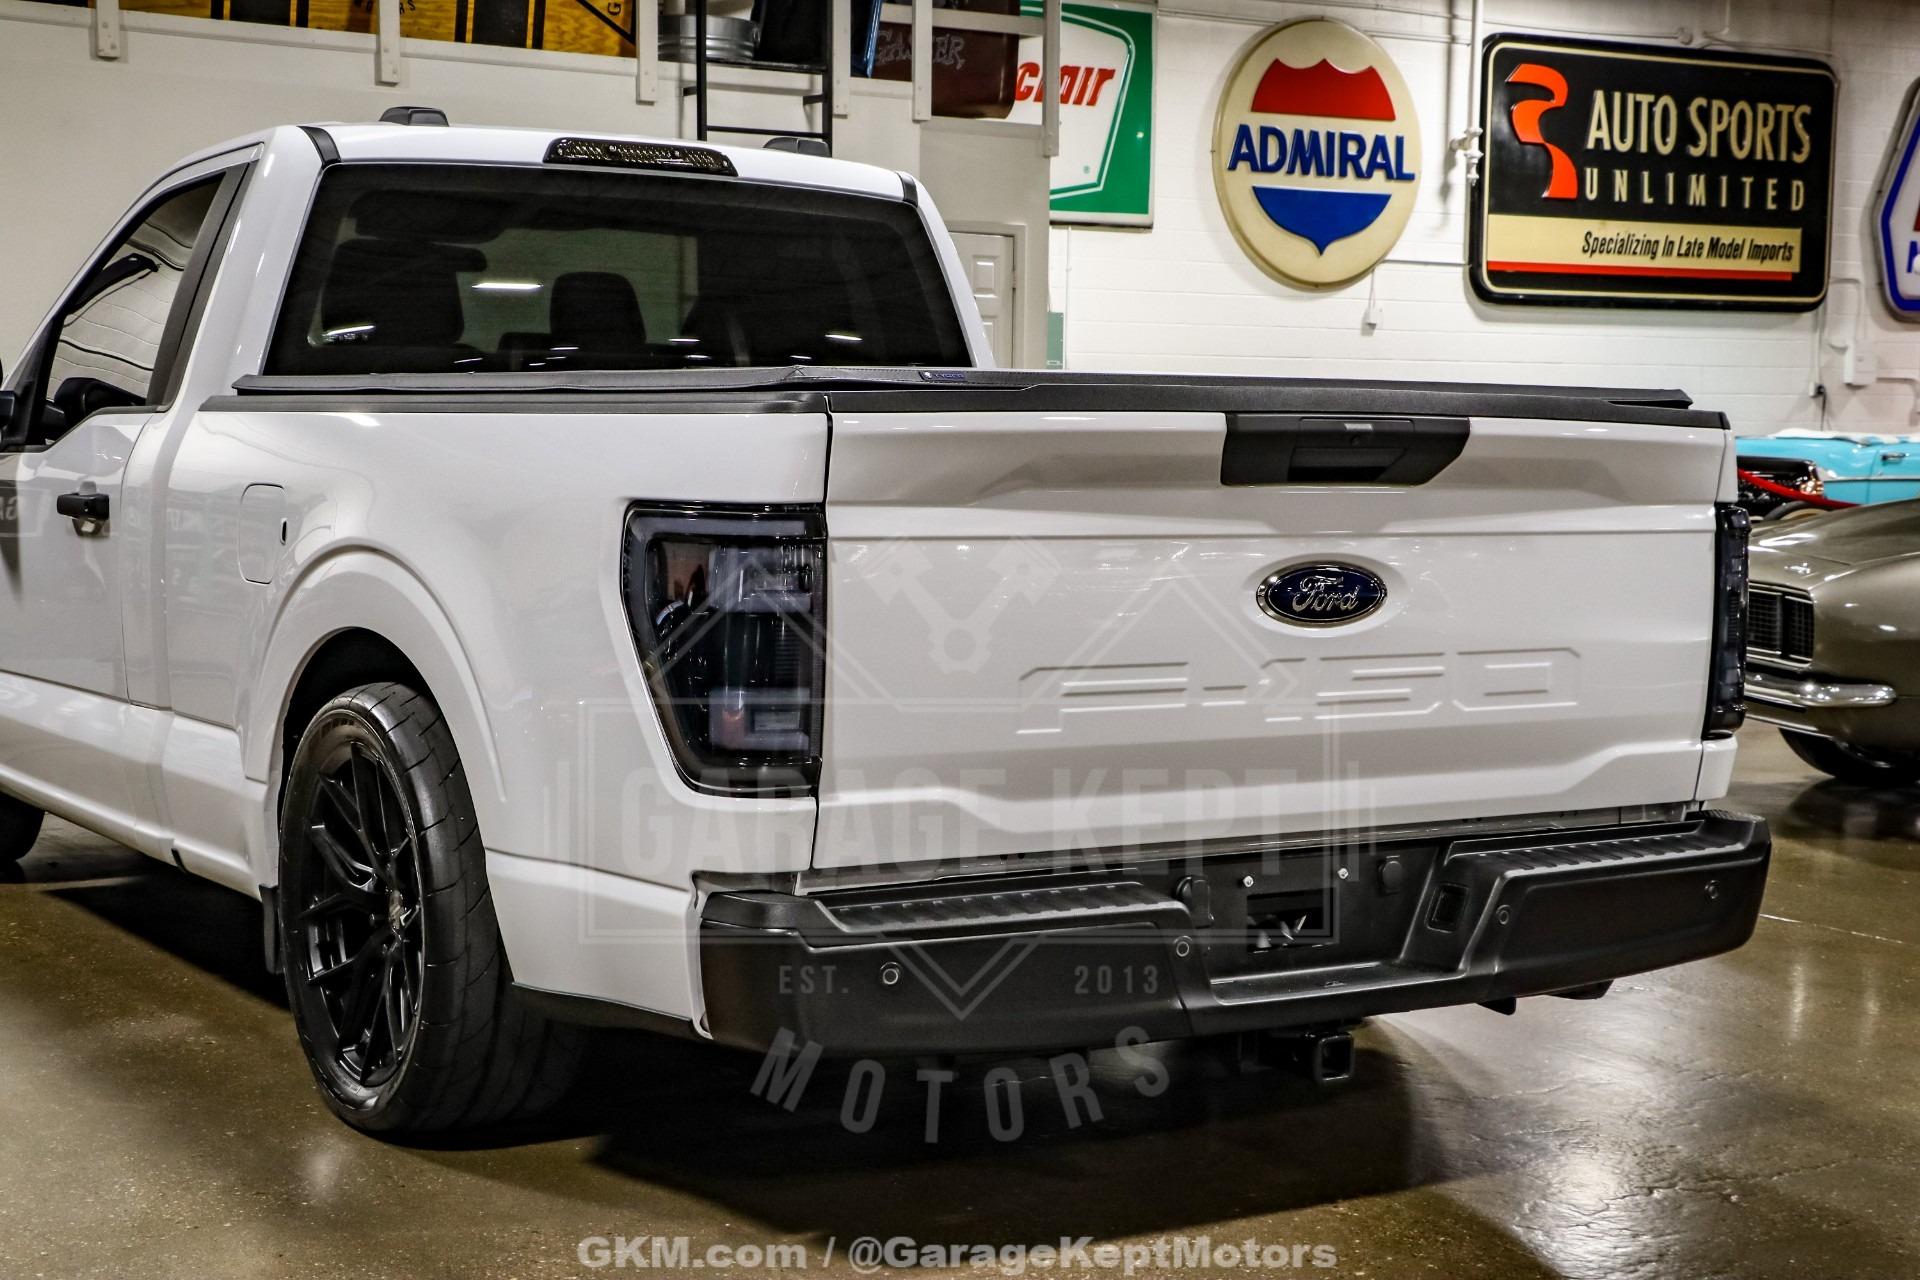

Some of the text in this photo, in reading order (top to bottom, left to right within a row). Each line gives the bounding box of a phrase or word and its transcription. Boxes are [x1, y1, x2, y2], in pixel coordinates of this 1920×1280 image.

[1586, 90, 1811, 163] AUTO SPORTS
[1228, 124, 1415, 181] ADMIRAL
[1584, 167, 1804, 211] UNLIMITED
[1582, 231, 1794, 264] Specializing In Late Model Imports
[1291, 575, 1361, 612] Ford
